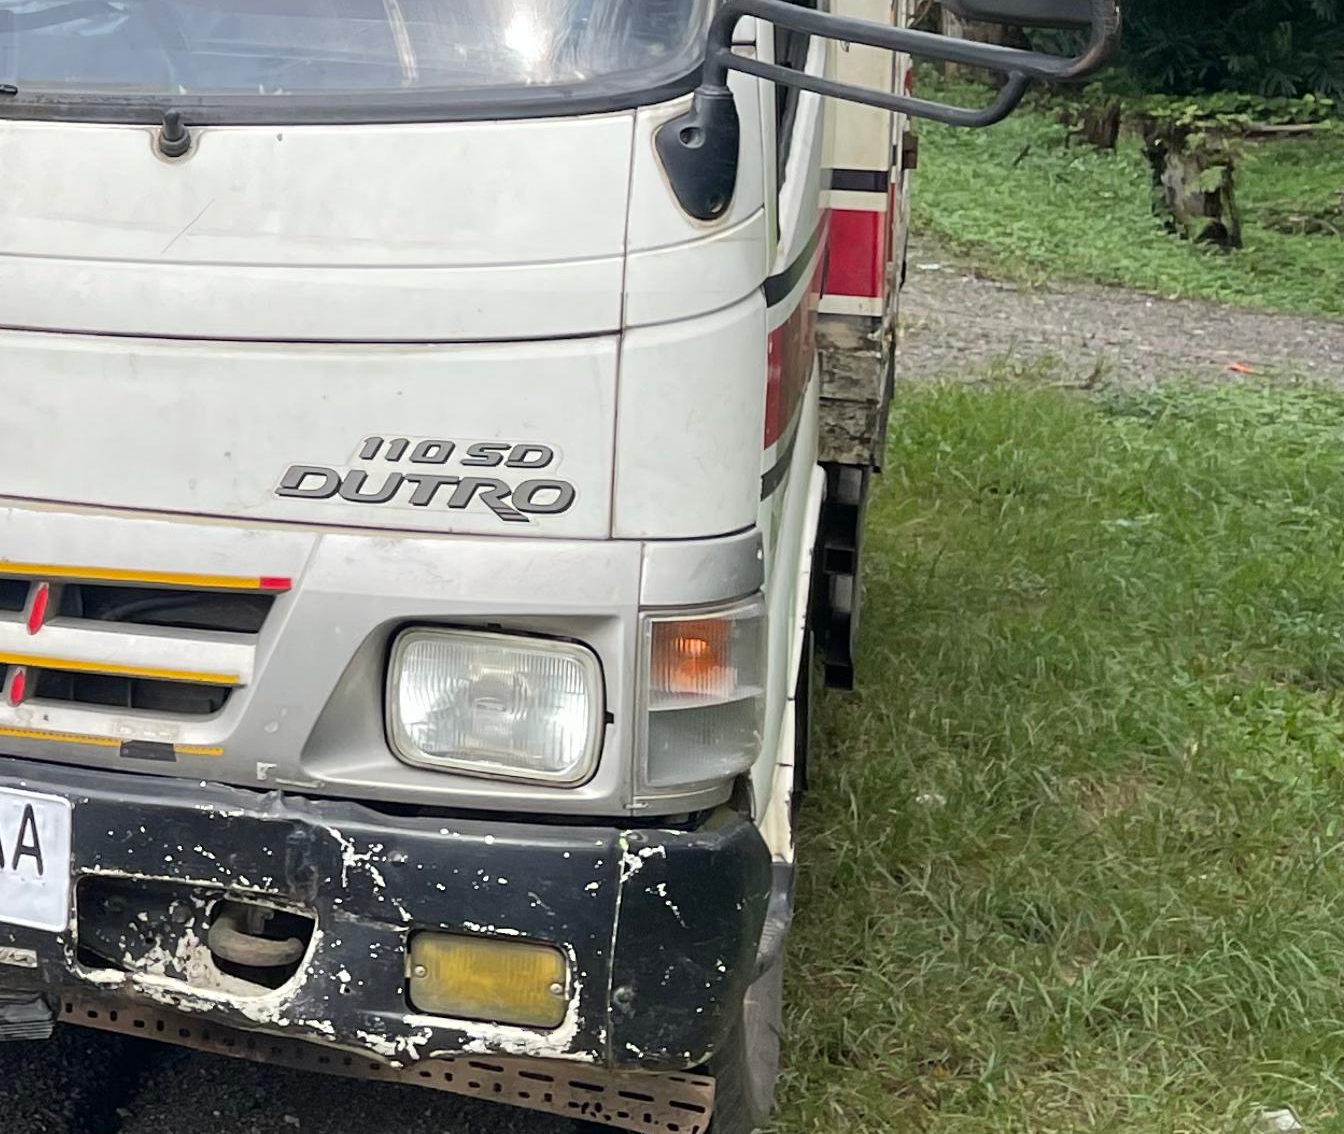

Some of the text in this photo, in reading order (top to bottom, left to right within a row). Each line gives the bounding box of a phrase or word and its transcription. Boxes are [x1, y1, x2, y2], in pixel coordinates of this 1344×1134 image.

[358, 436, 555, 469] 110 SD
[273, 464, 576, 523] DUTRO
